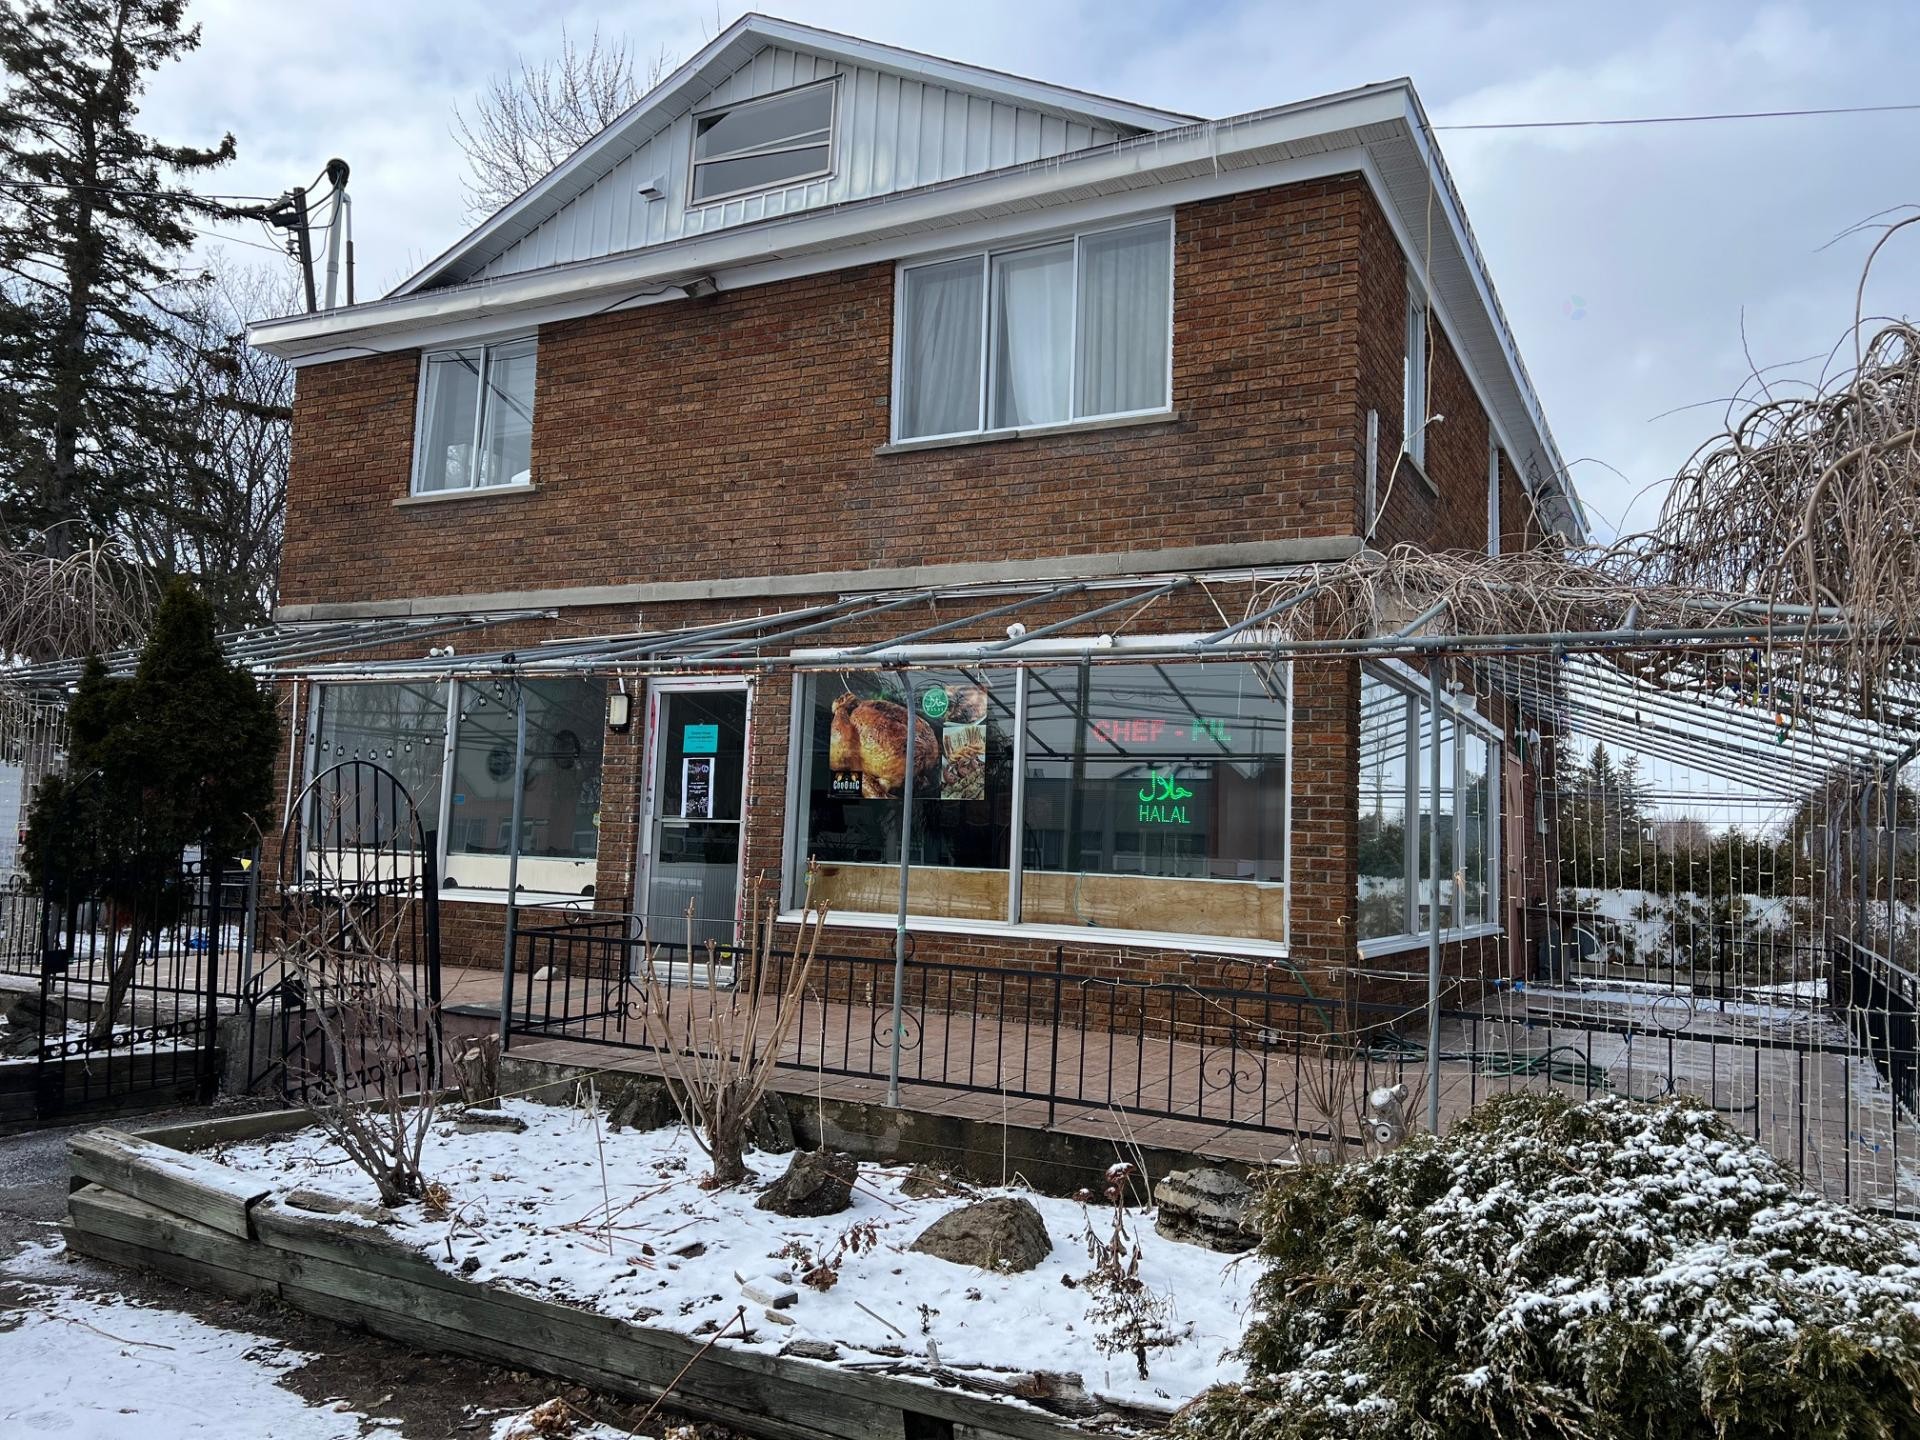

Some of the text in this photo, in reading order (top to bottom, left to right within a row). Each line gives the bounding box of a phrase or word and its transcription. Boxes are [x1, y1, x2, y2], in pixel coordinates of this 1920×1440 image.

[1092, 719, 1166, 742] CHEF
[1139, 769, 1193, 802] حلال
[1139, 804, 1191, 823] HALAL
